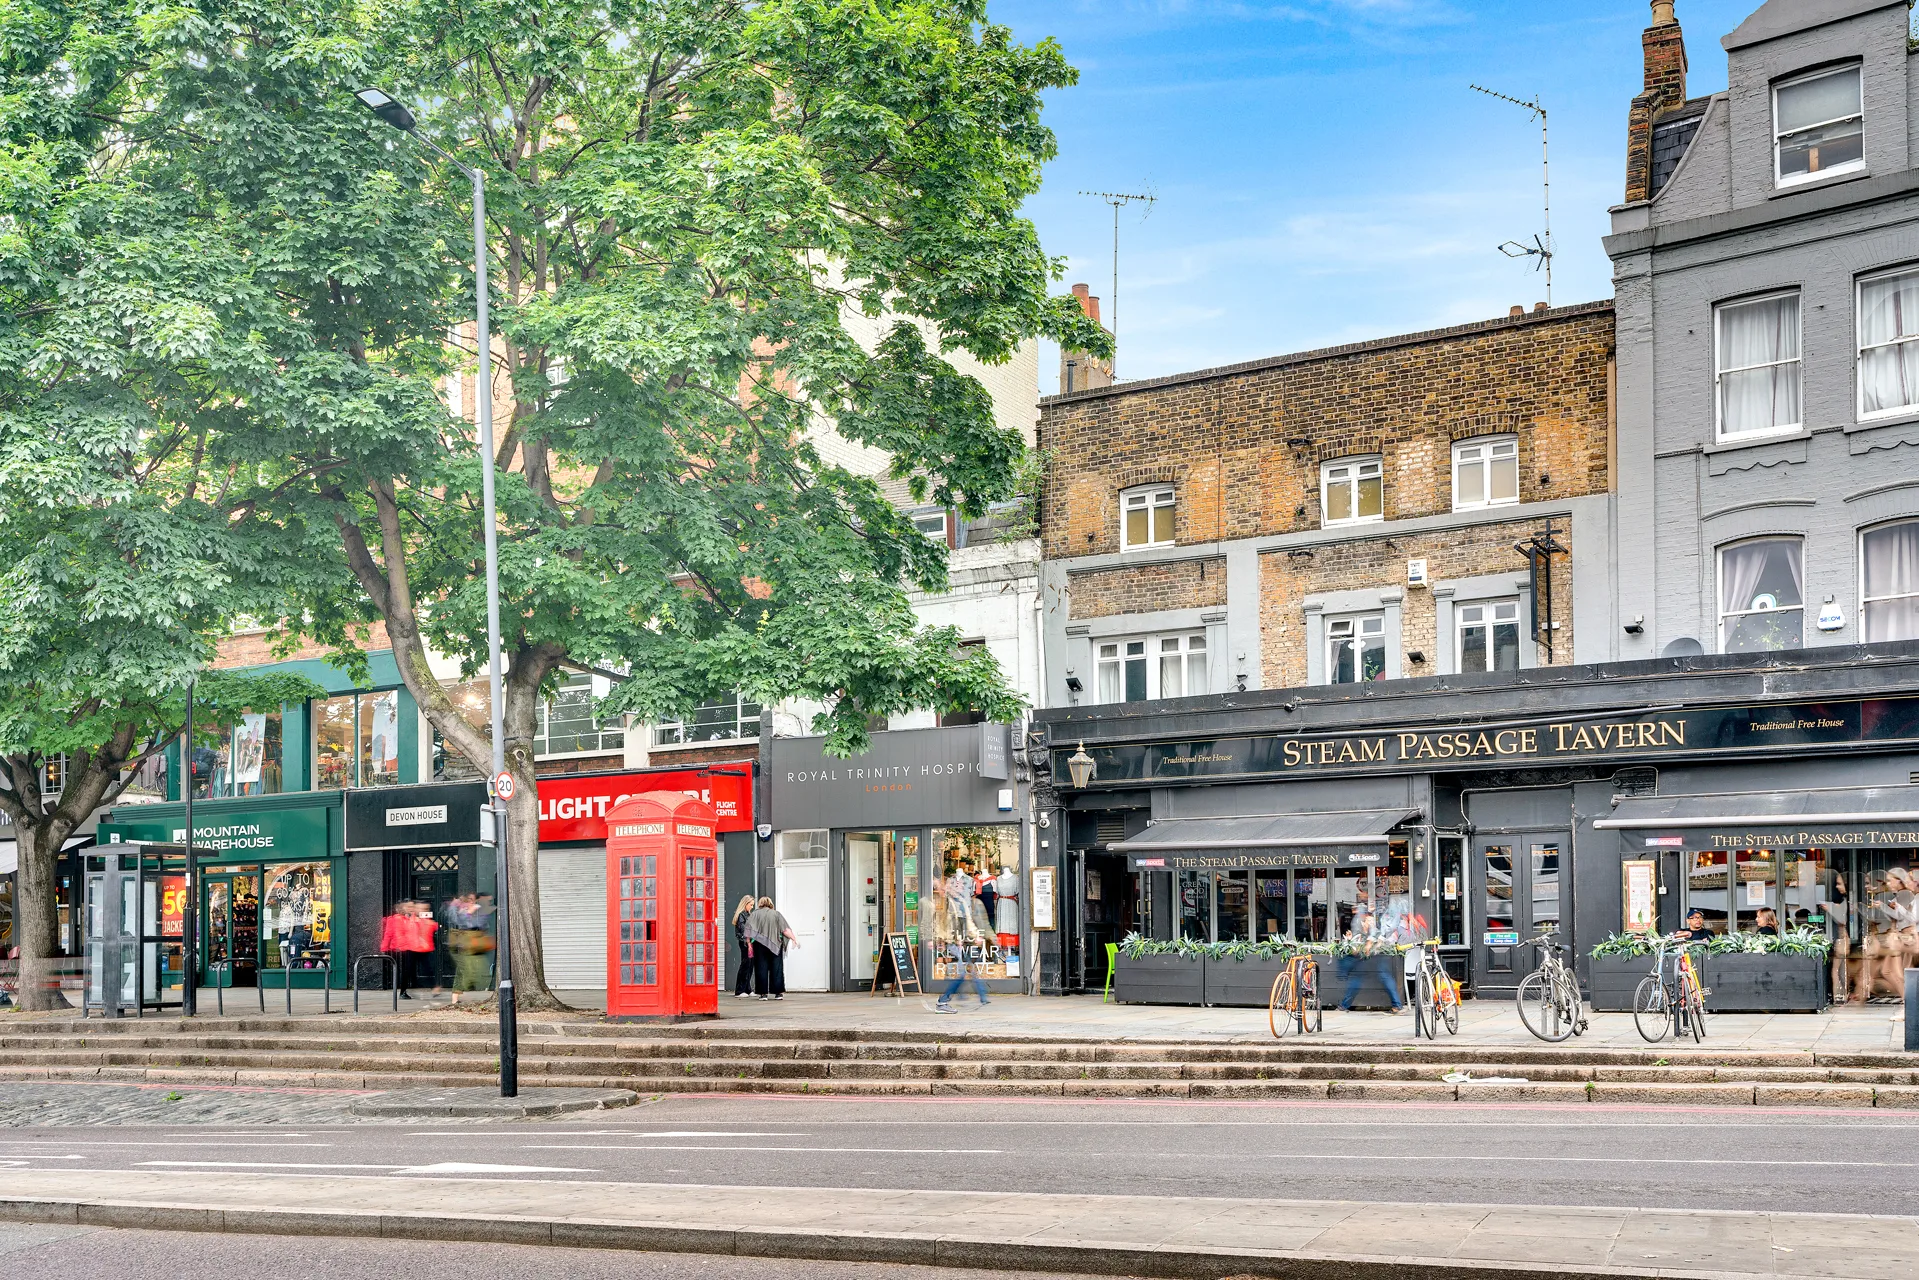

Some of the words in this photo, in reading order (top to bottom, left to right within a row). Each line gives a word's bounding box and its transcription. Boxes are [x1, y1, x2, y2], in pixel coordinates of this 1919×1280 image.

[1749, 720, 1796, 732] Traditional
[1797, 719, 1816, 729] Free
[1816, 718, 1845, 728] House
[1283, 738, 1387, 767] STEAM
[1397, 729, 1538, 760] PASSAGE
[1549, 720, 1687, 751] TAVERN
[1162, 754, 1197, 765] Traditional
[1197, 754, 1212, 763] Free
[1212, 753, 1233, 762] House
[787, 769, 838, 783] ROYAL
[846, 765, 912, 779] TRINITY
[498, 780, 512, 792] 20
[865, 783, 912, 793] London
[716, 801, 736, 809] FLIGHT
[390, 811, 416, 822] DEVON
[417, 809, 443, 820] HOUSE
[716, 808, 738, 817] CENTRE
[193, 824, 260, 839] MOUNTAIN
[617, 823, 665, 836] TELEPHONE
[678, 824, 710, 837] TELEPHONE
[192, 836, 275, 850] WAREHOUSE
[1711, 834, 1743, 847] THE
[1745, 833, 1795, 846] STEAM
[1797, 832, 1864, 845] PASSAGE
[1866, 830, 1919, 844] TAVER
[1173, 857, 1197, 868] THE
[1199, 856, 1237, 867] STEAM
[1239, 855, 1290, 867] PASSAGE
[1291, 854, 1339, 866] TAVERN
[281, 873, 293, 885] UP
[296, 872, 310, 885] TO
